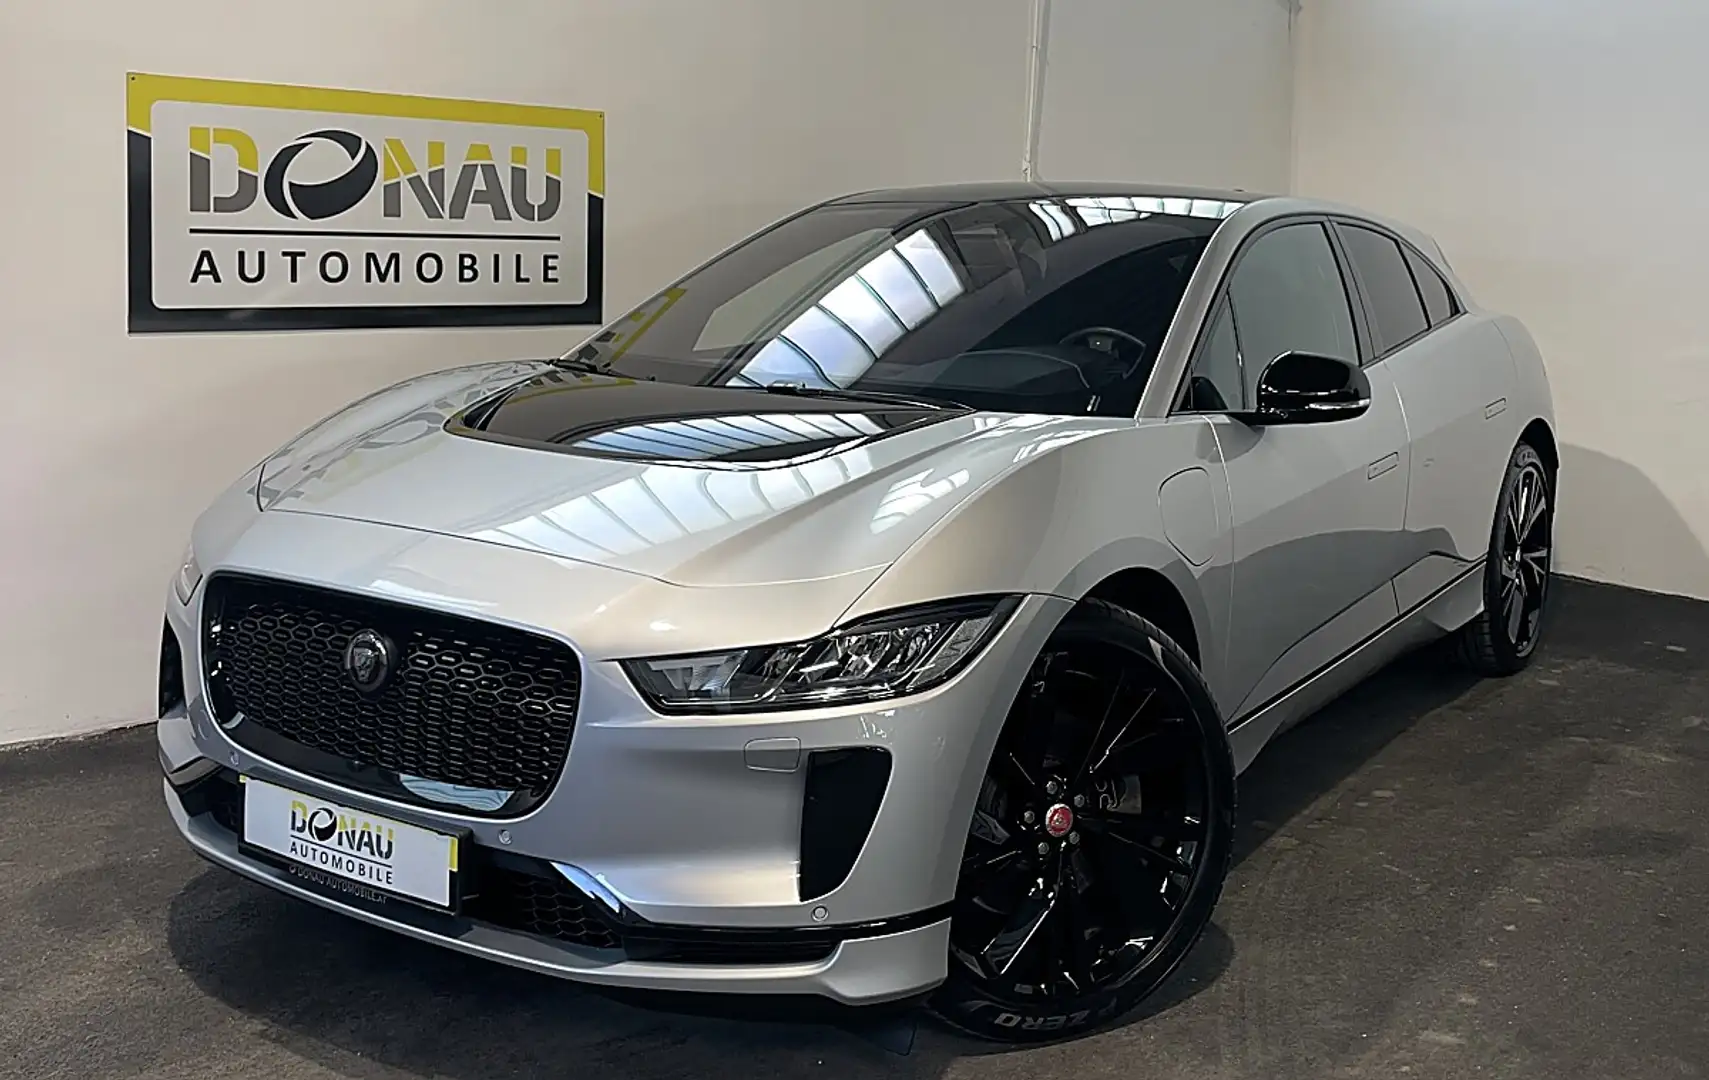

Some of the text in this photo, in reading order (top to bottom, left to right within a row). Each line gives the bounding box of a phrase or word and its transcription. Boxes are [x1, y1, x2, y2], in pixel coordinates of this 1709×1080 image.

[190, 127, 561, 222] DONAU
[190, 250, 560, 283] AUTOMOBILE
[291, 800, 394, 859] DONAU
[289, 841, 393, 884] AUTOMOBILE
[994, 1010, 1091, 1030] ZERO
